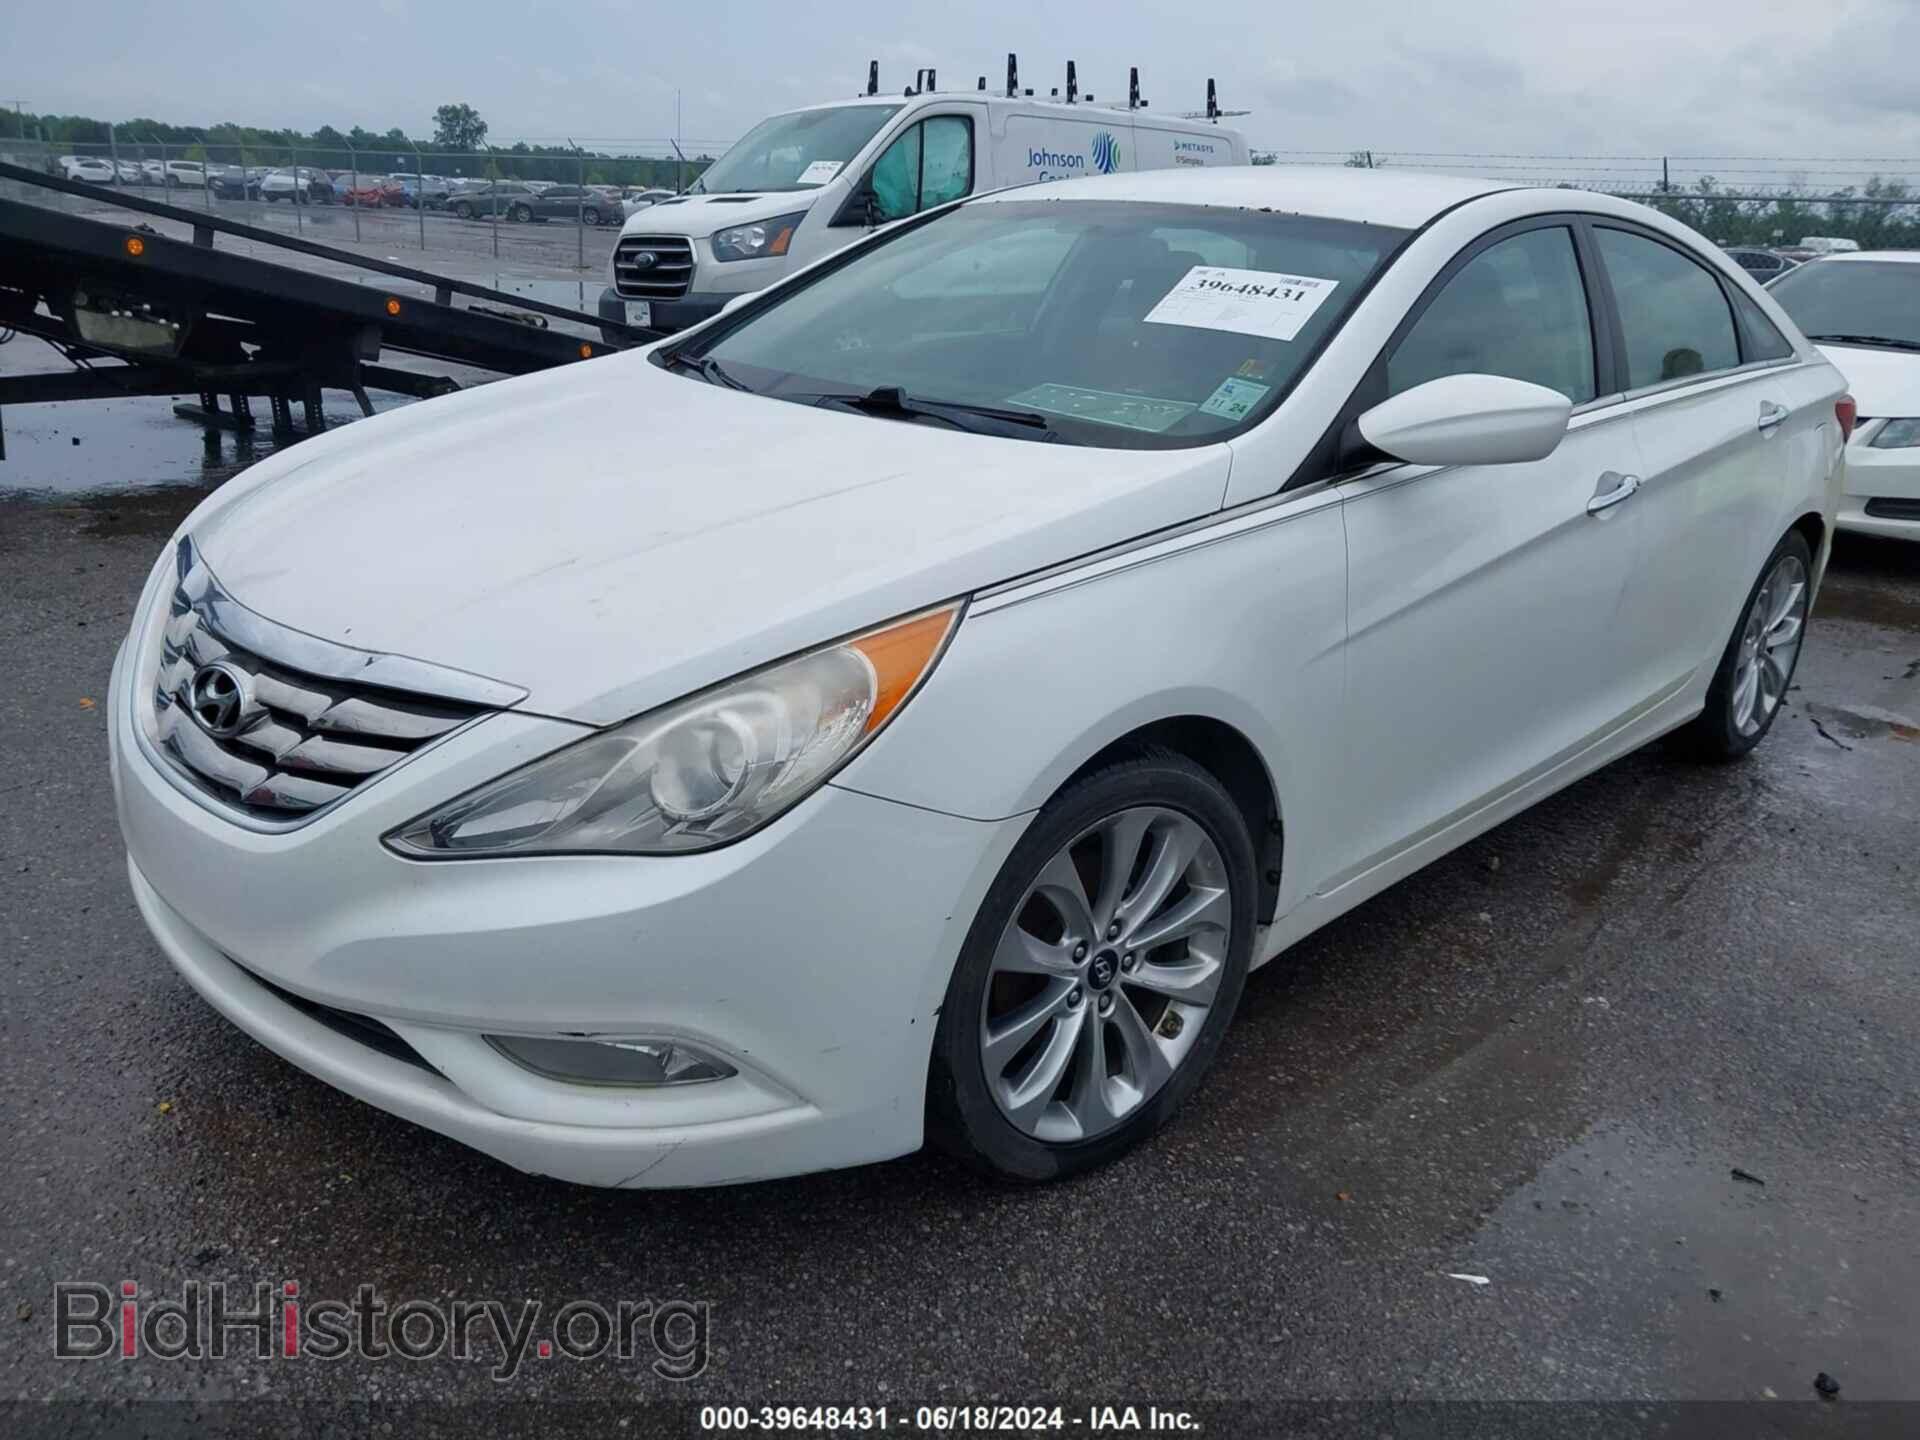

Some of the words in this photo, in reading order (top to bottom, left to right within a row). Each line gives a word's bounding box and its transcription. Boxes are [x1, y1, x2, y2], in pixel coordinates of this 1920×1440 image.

[1027, 147, 1084, 168] Johnson
[1191, 278, 1306, 302] 39648431
[1229, 402, 1248, 414] 24
